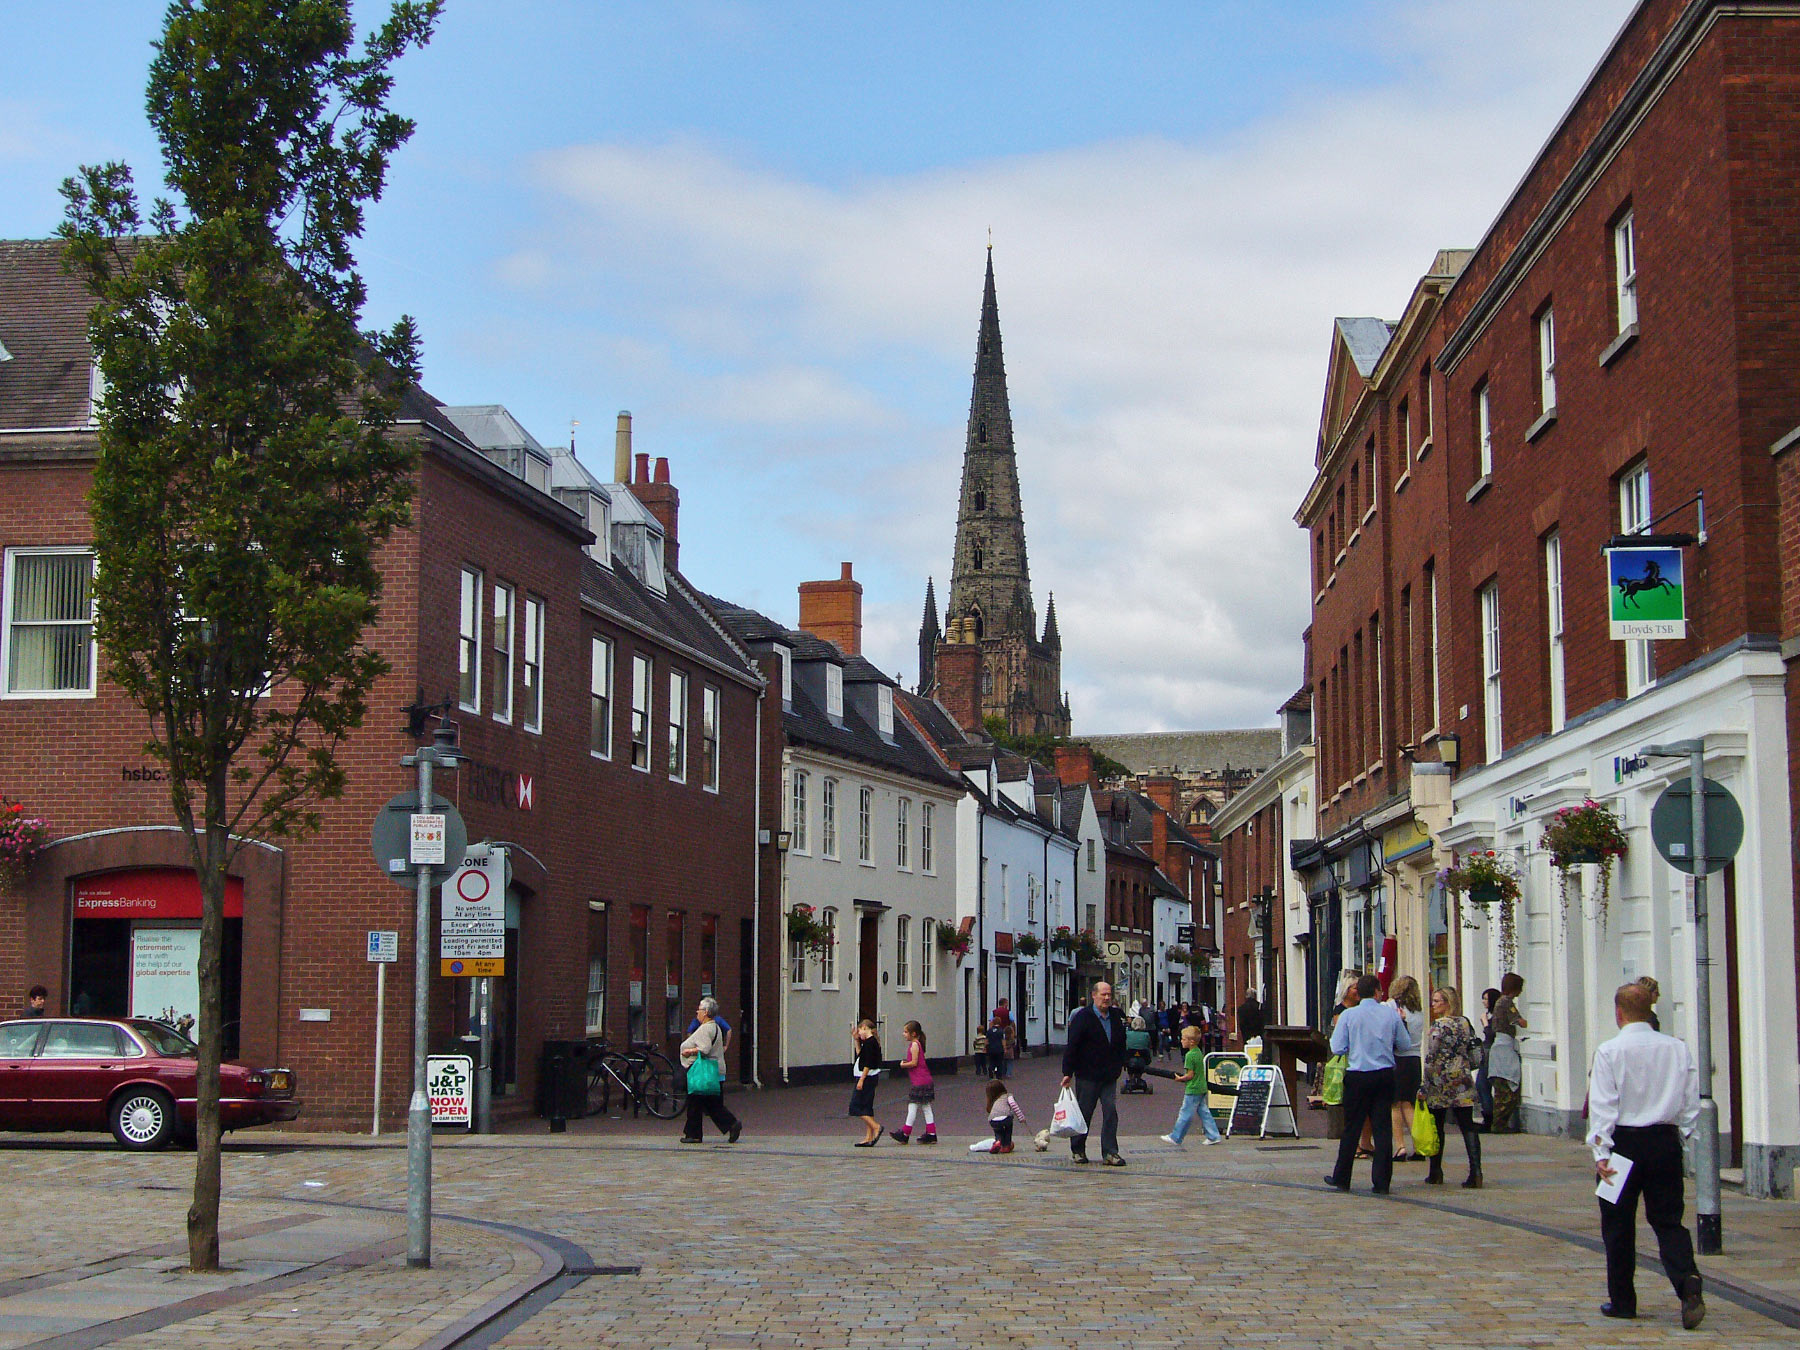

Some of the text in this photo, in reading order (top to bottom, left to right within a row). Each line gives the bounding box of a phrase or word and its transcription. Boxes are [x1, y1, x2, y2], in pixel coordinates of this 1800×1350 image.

[1622, 624, 1674, 636] Lloyds TSB
[460, 858, 488, 867] ONE
[78, 897, 156, 909] ExpressBanking
[136, 969, 190, 977] global expertise
[429, 1076, 466, 1088] J&P
[430, 1097, 464, 1106] NOW
[431, 1107, 467, 1116] OPEN
